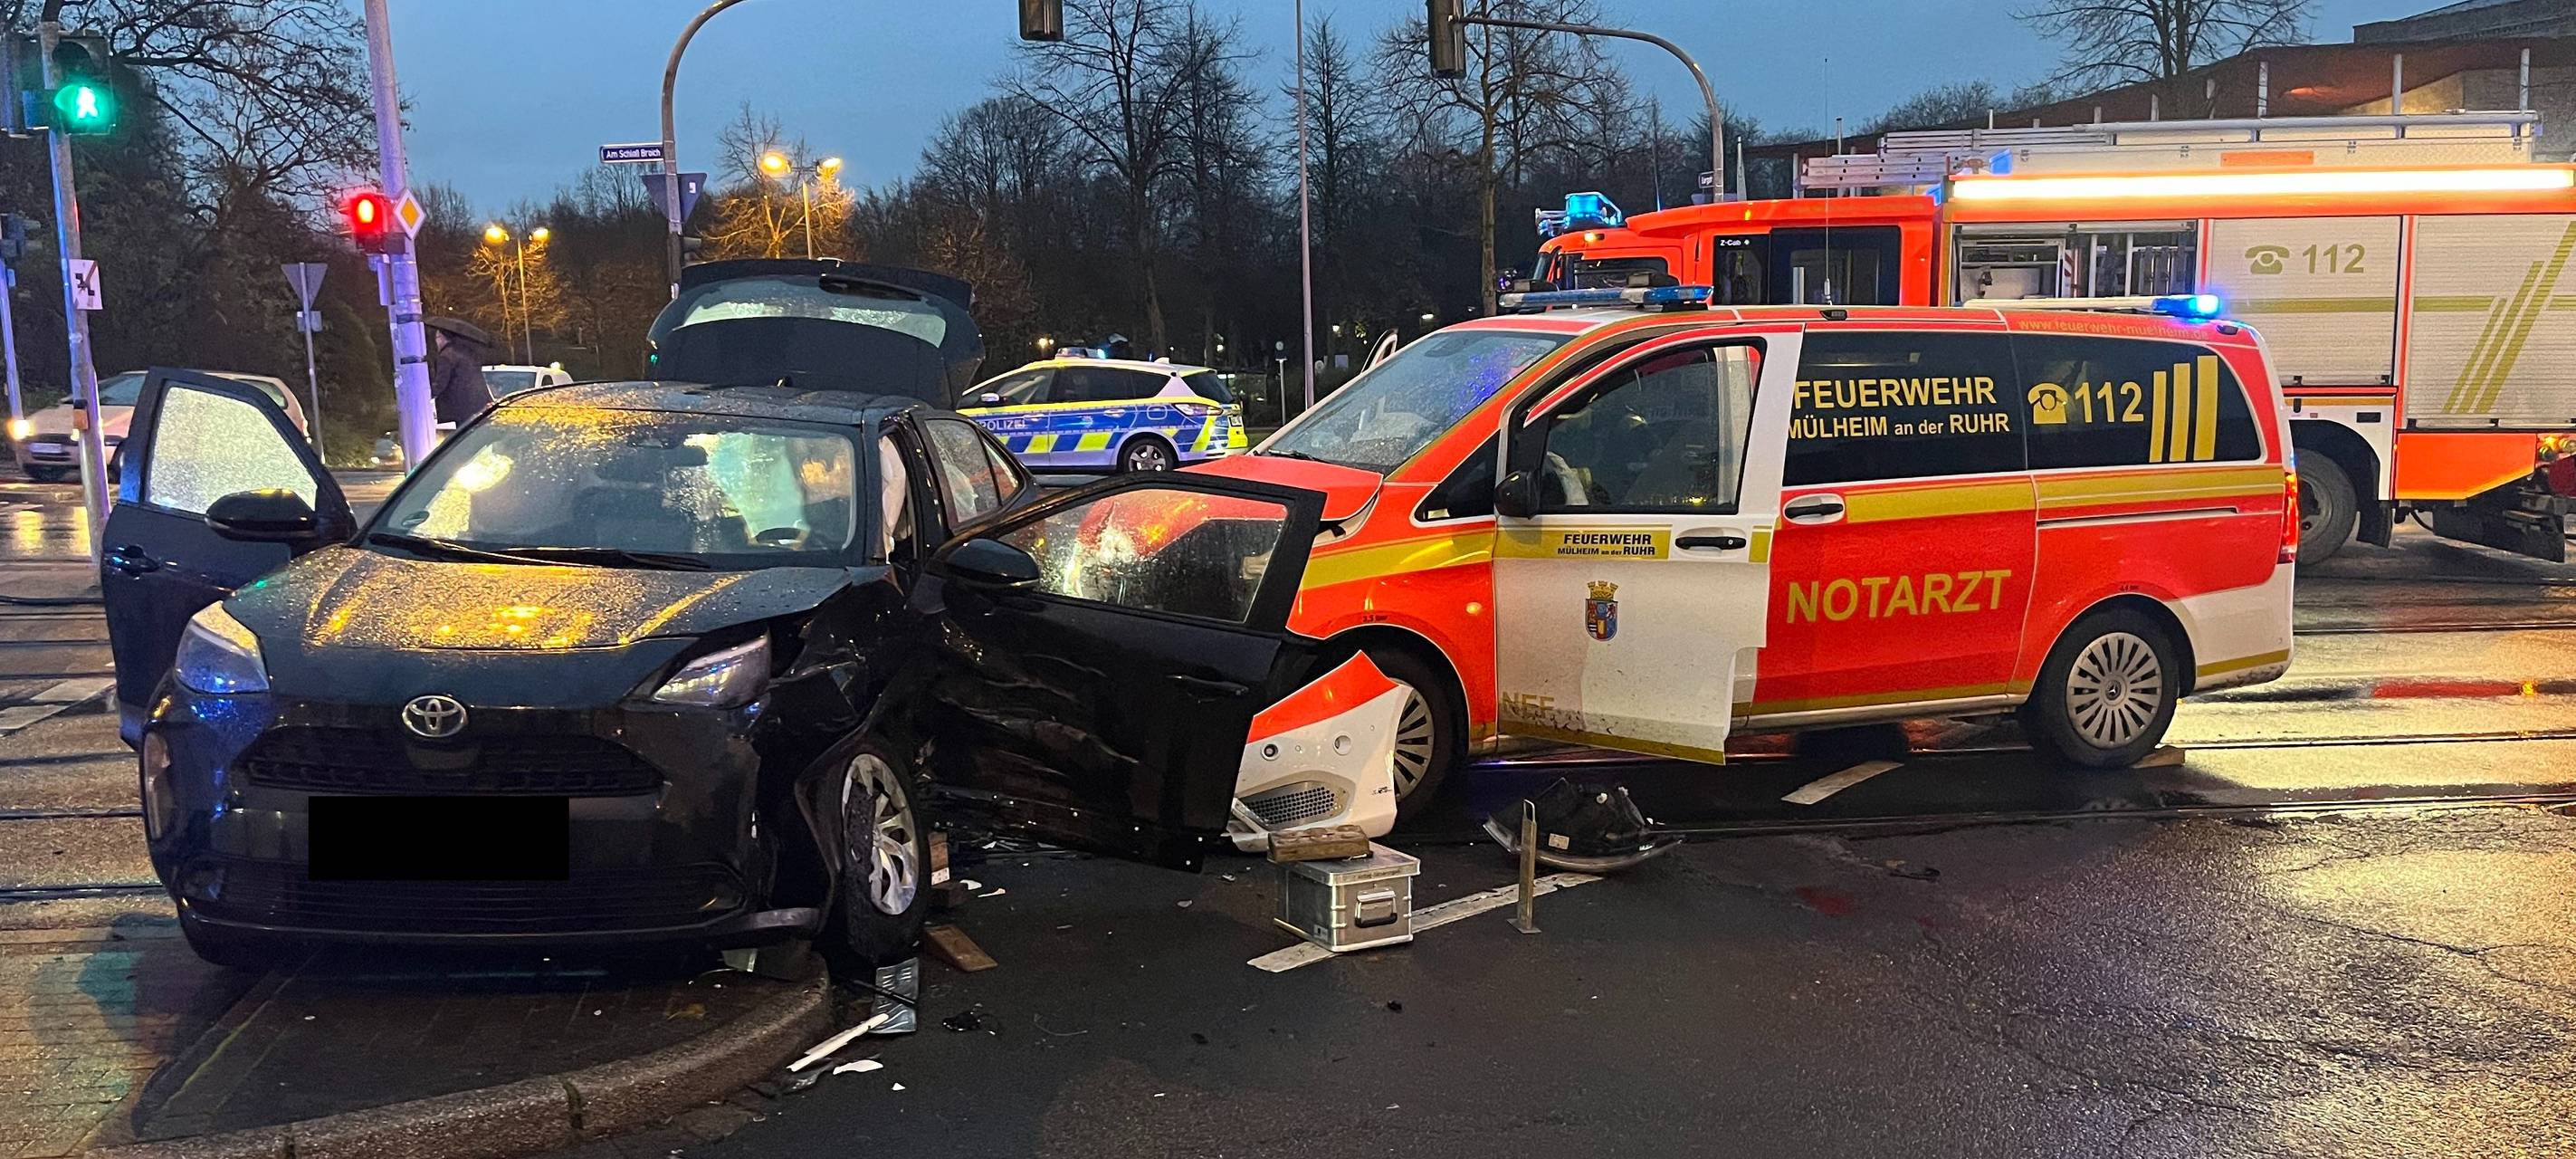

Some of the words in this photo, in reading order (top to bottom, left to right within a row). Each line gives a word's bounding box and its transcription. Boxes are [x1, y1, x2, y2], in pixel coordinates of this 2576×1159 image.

[606, 150, 618, 158] Am
[641, 148, 662, 158] Broich
[2303, 244, 2365, 273] 112
[1793, 377, 1997, 409] FEUERWEHR
[2075, 381, 2144, 423] 112
[1788, 415, 1888, 439] MÜLHEIM
[1894, 423, 1913, 436] an
[1918, 419, 1944, 435] der
[1950, 413, 2010, 434] RUHR
[1558, 546, 1599, 555] MÜLHEIM
[1623, 546, 1655, 555] RUHR
[1564, 533, 1652, 545] FEUERWEHR
[1787, 570, 2011, 624] NOTARZT
[1503, 692, 1554, 718] NEF
